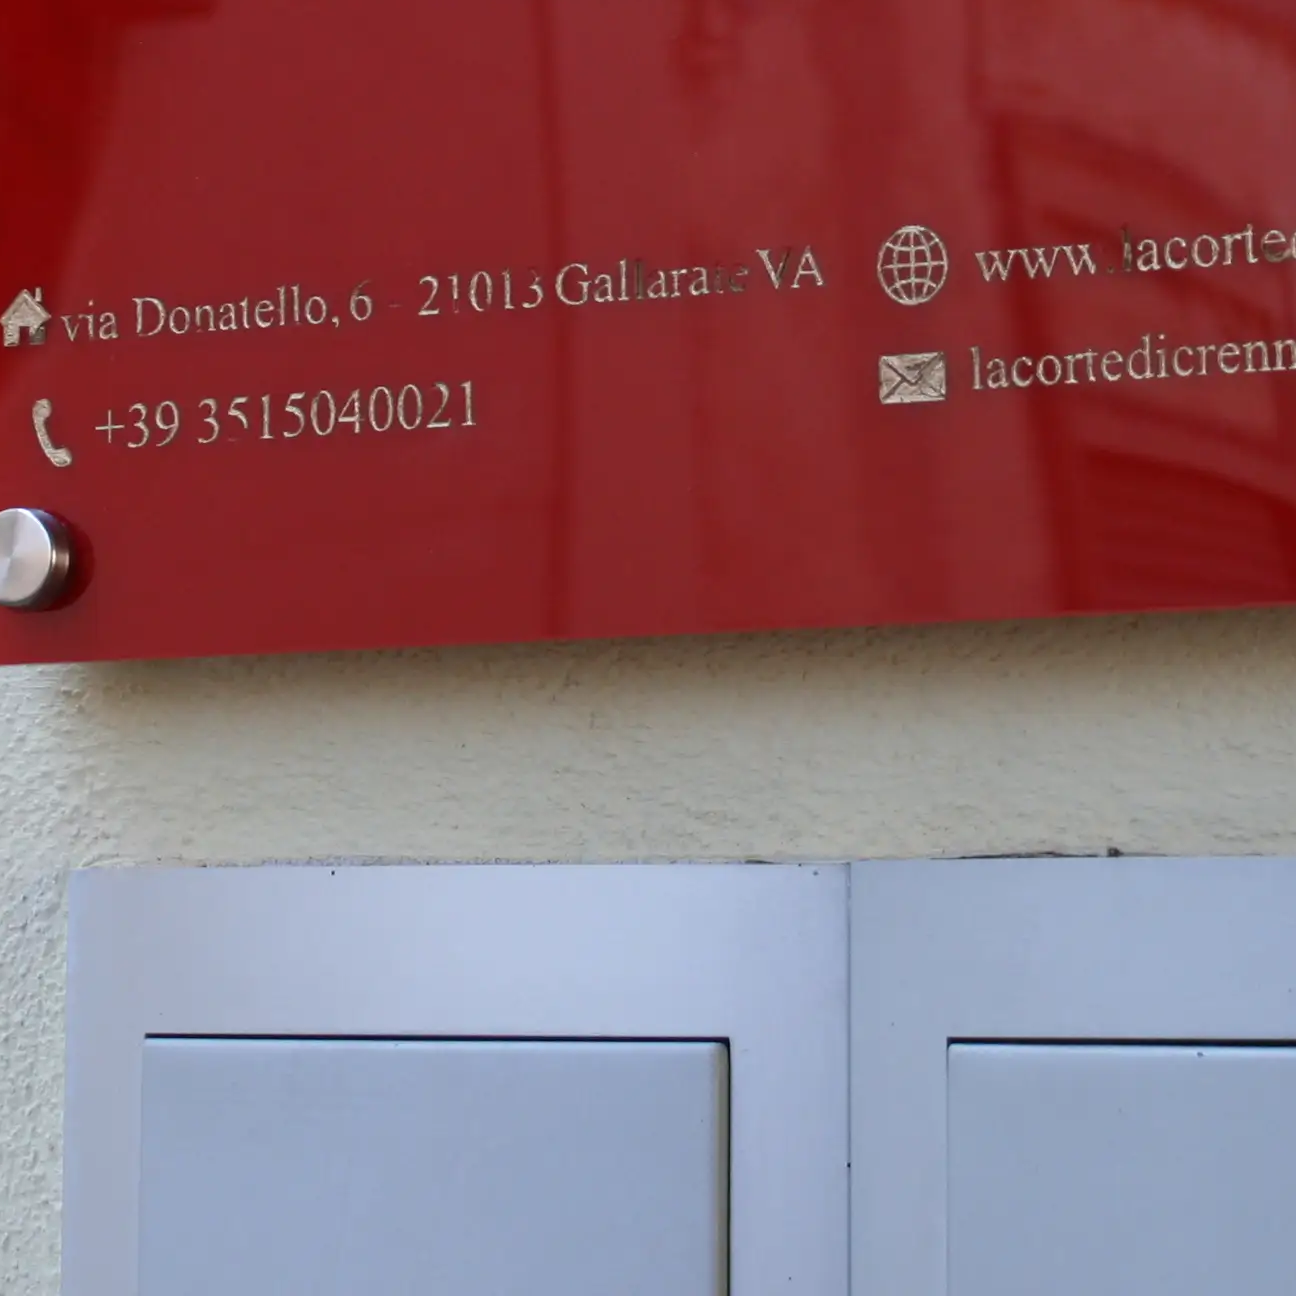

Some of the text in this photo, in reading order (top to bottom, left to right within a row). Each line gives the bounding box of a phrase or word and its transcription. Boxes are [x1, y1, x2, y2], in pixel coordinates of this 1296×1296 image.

[60, 299, 119, 342] via
[131, 283, 340, 338] Donatello,
[349, 278, 374, 322] 6
[417, 268, 545, 316] 21013
[555, 257, 750, 306] Gallarate
[754, 244, 825, 290] VA
[94, 380, 478, 448] +39 3515040021
